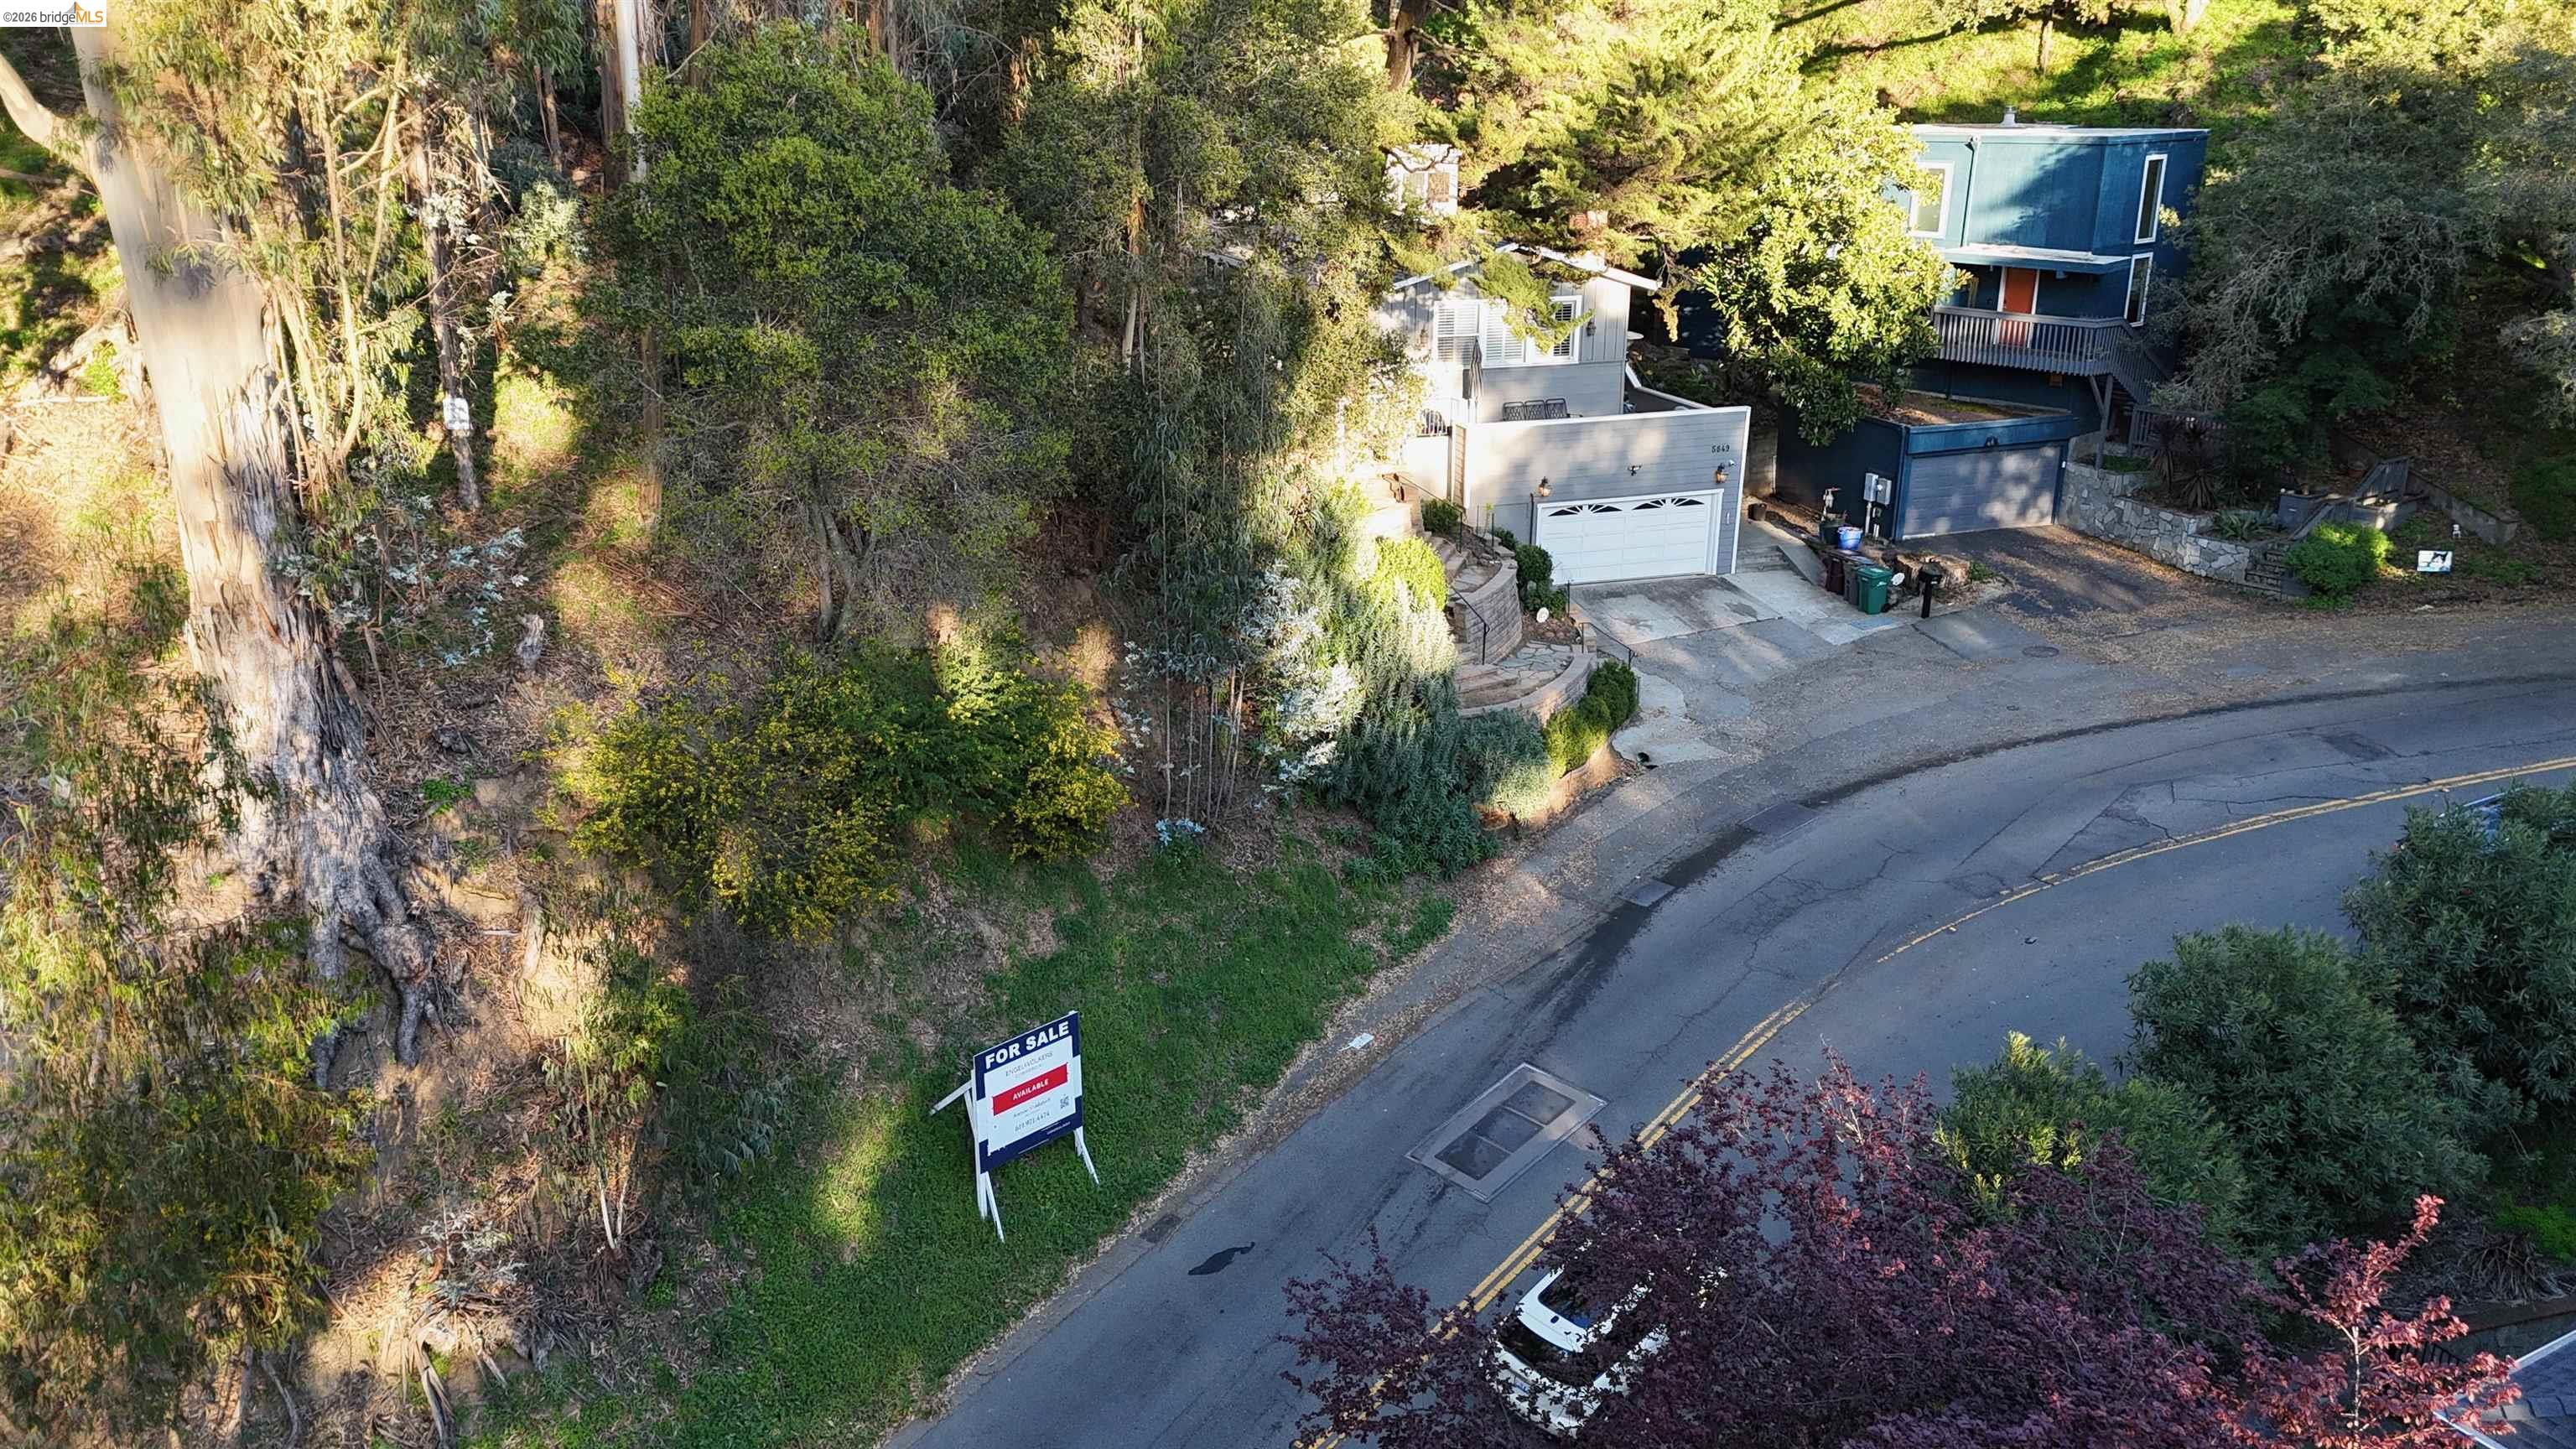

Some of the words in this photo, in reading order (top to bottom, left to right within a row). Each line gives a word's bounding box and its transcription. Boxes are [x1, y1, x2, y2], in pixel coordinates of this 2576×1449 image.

[985, 1042, 1021, 1069] FOR
[1026, 1021, 1069, 1051] SALE
[1013, 1078, 1049, 1100] AVAILABLE
